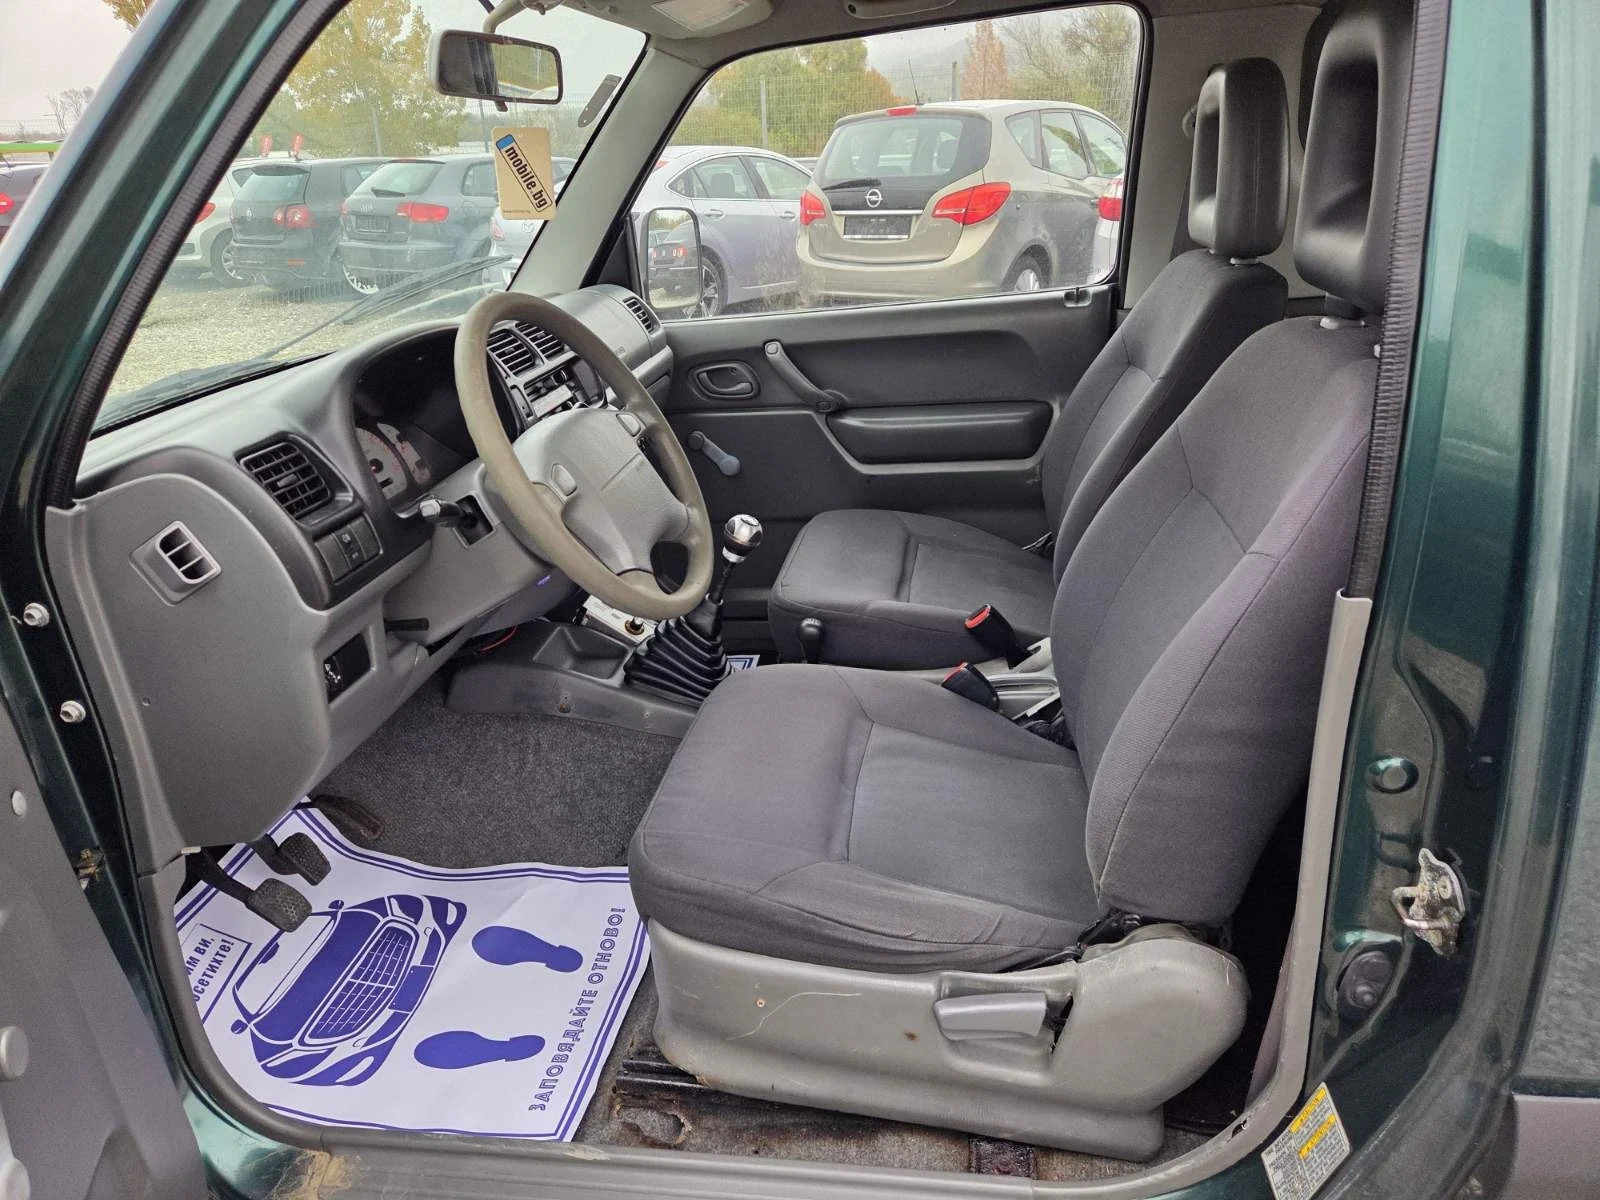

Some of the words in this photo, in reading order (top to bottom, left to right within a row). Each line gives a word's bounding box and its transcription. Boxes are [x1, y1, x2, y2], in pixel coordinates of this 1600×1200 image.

[504, 146, 548, 209] mobile.bg
[528, 989, 598, 1111] ЗАПОВЯДАЙТЕ
[587, 907, 626, 985] ОТНОВО!
